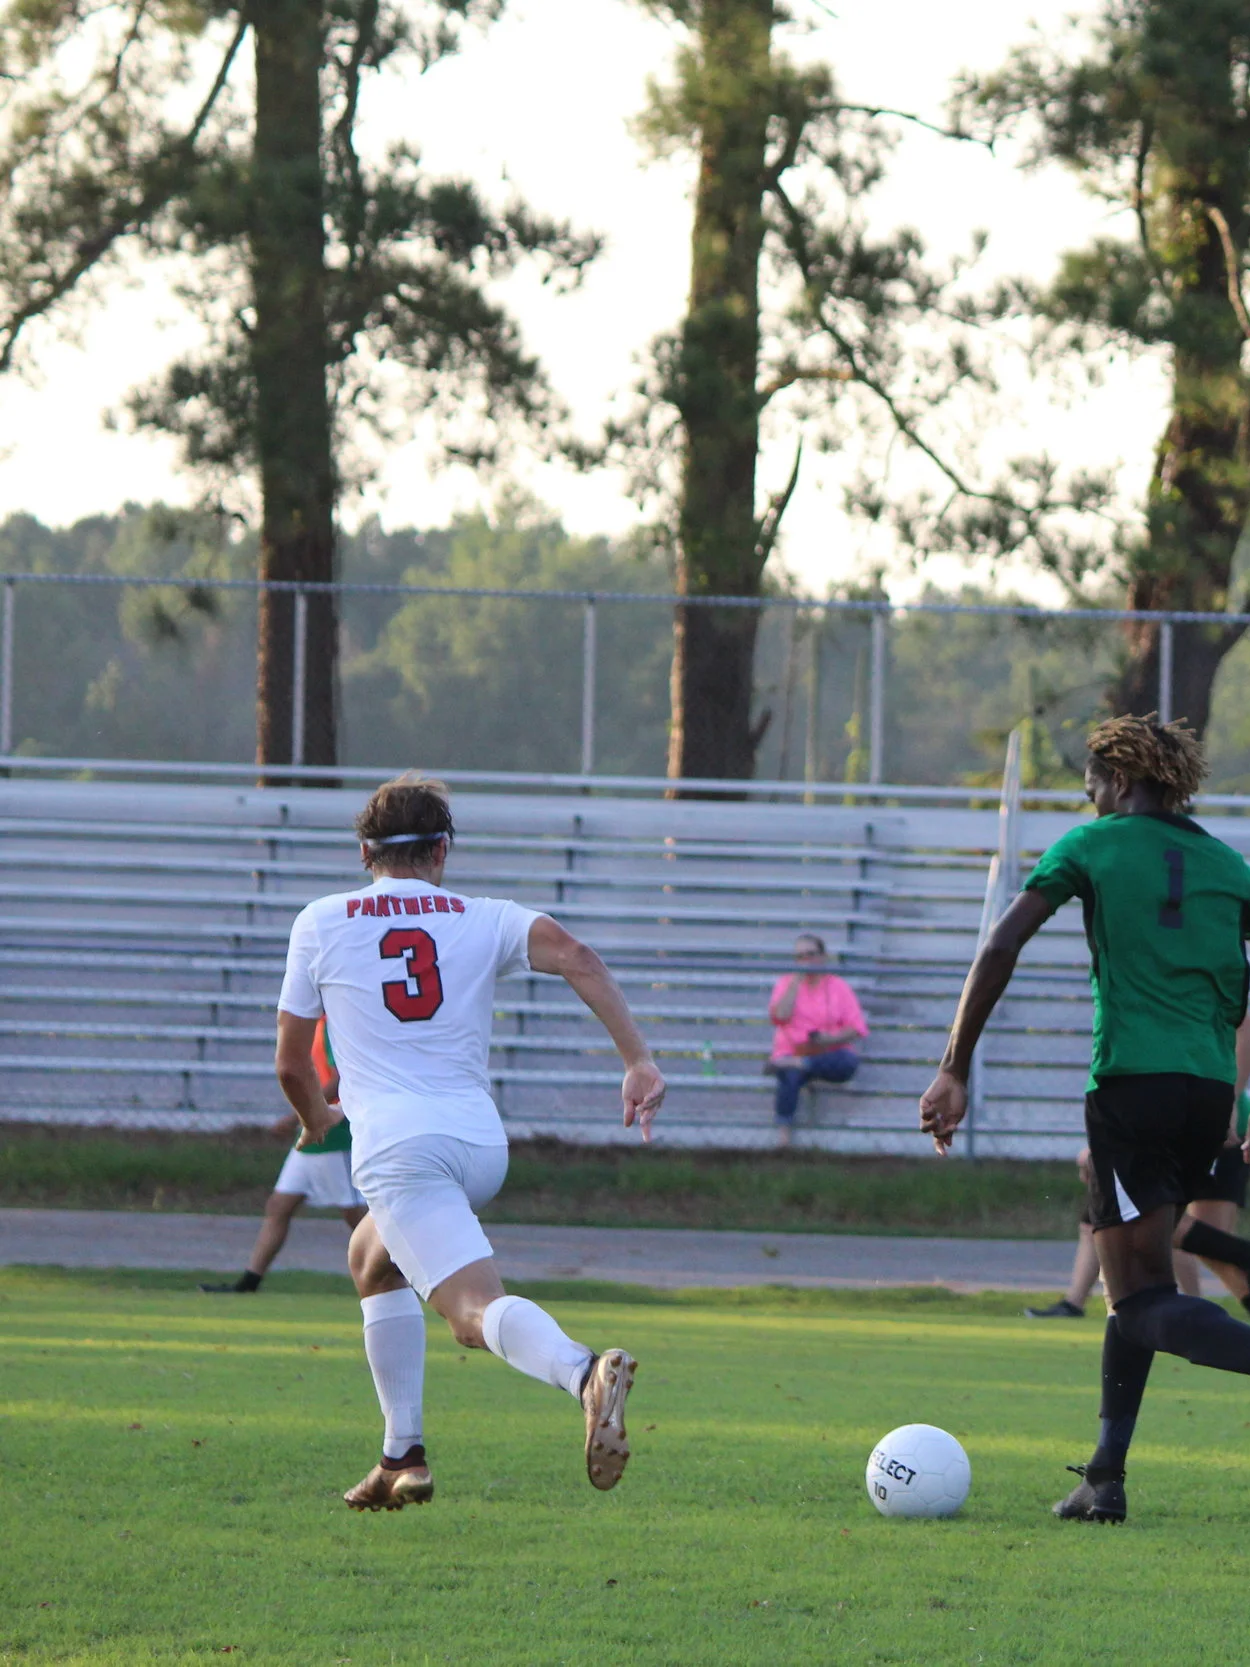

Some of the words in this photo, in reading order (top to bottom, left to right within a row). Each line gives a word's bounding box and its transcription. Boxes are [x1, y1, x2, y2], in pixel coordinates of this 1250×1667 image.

[347, 894, 465, 918] PANTHERS
[1160, 849, 1184, 929] 1
[379, 927, 444, 1022] 3
[874, 1481, 887, 1501] 10
